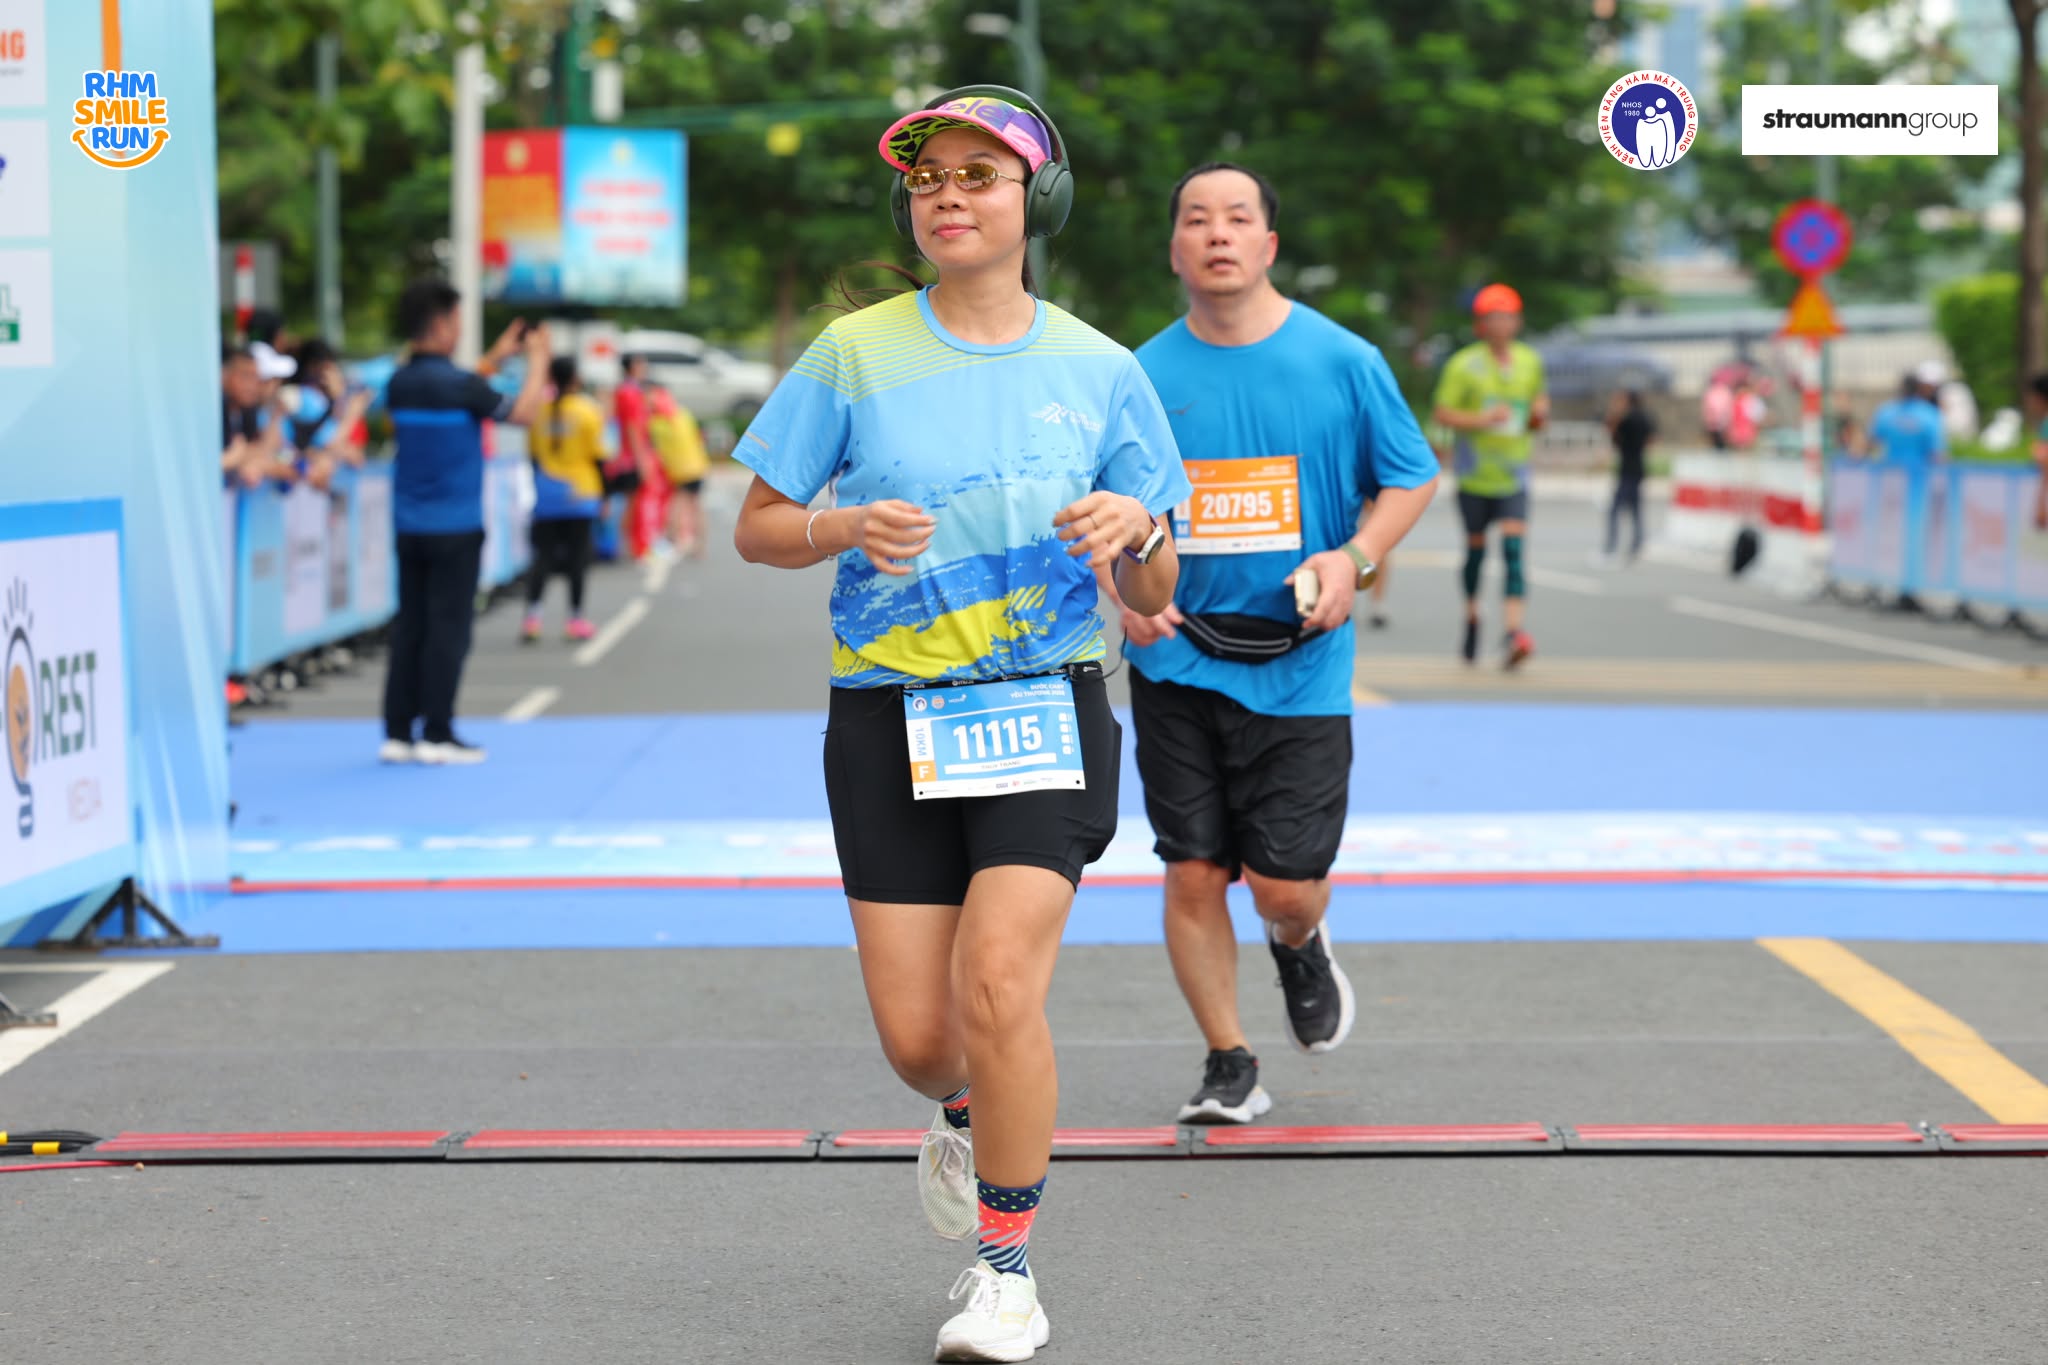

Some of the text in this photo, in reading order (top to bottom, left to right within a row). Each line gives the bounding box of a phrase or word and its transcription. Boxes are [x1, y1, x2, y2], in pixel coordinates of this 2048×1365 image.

[1201, 491, 1273, 519] 20795
[915, 727, 927, 756] 10KM
[953, 715, 1043, 760] 11115
[918, 765, 929, 779] F
